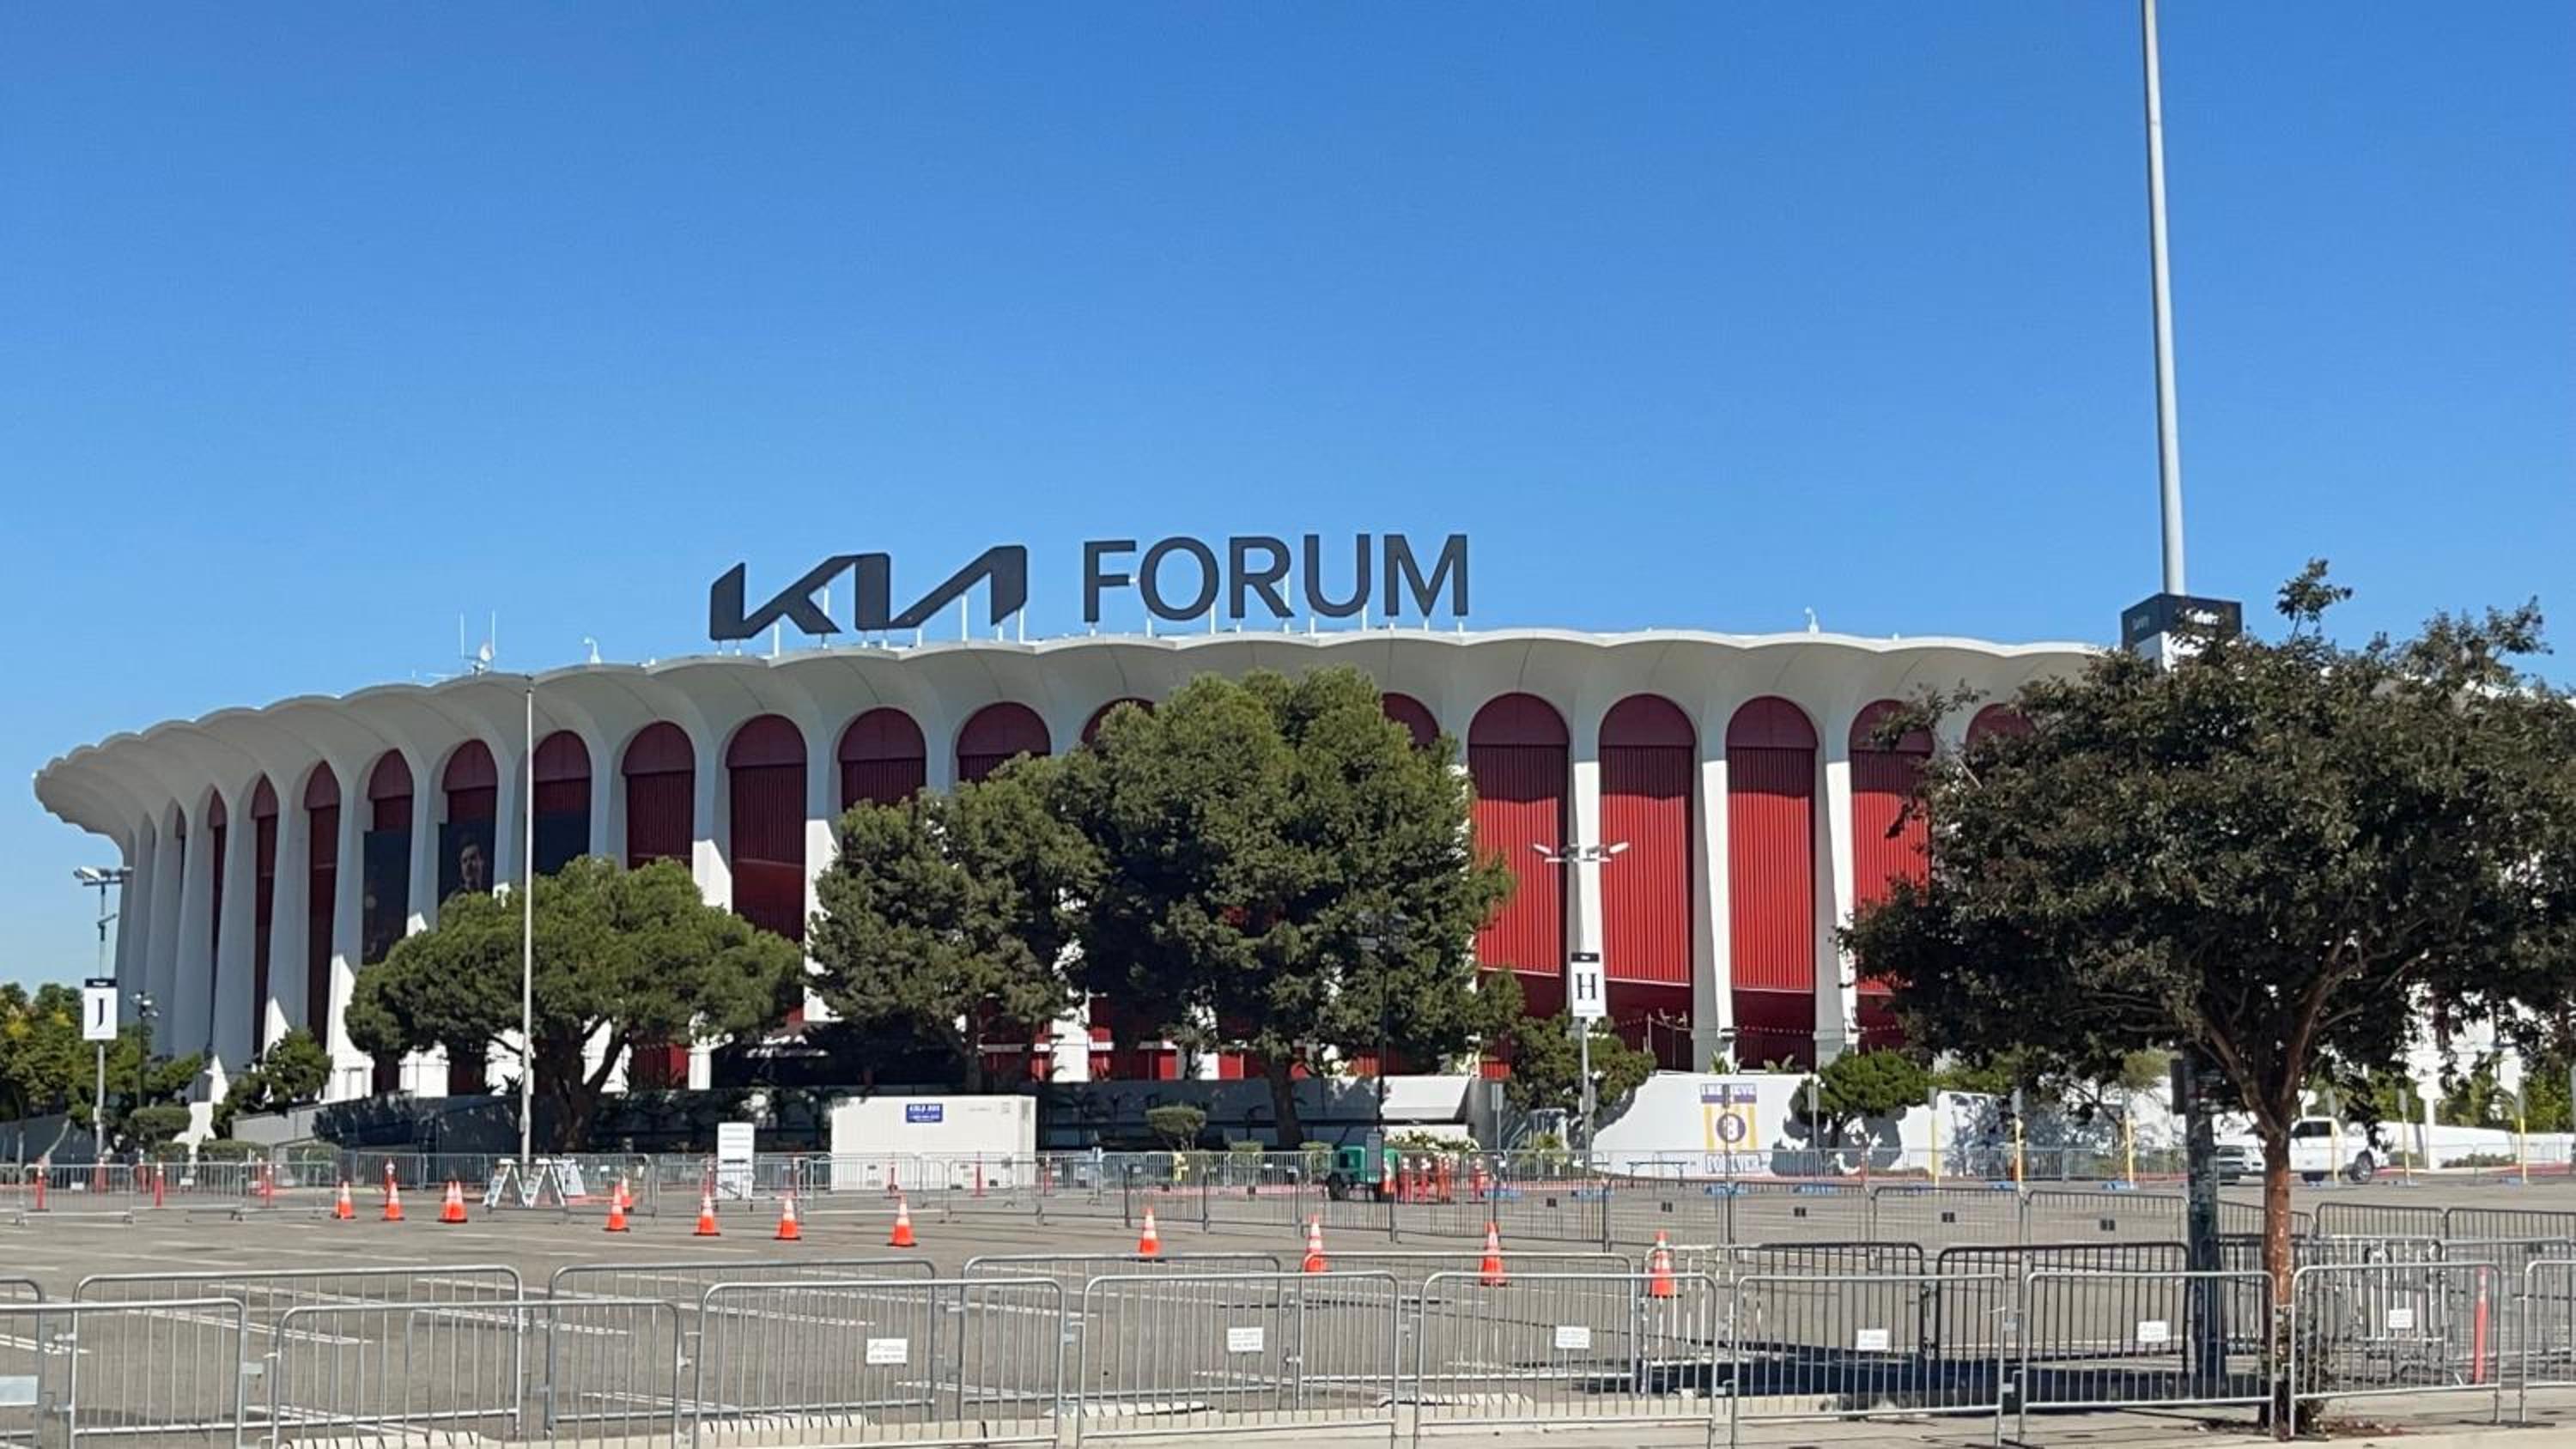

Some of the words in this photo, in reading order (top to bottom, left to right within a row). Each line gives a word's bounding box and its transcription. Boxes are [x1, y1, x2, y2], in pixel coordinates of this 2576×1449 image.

[710, 544, 1027, 640] KIA
[1084, 533, 1468, 623] FORUM
[1575, 972, 1597, 1001] H
[95, 997, 105, 1028] J
